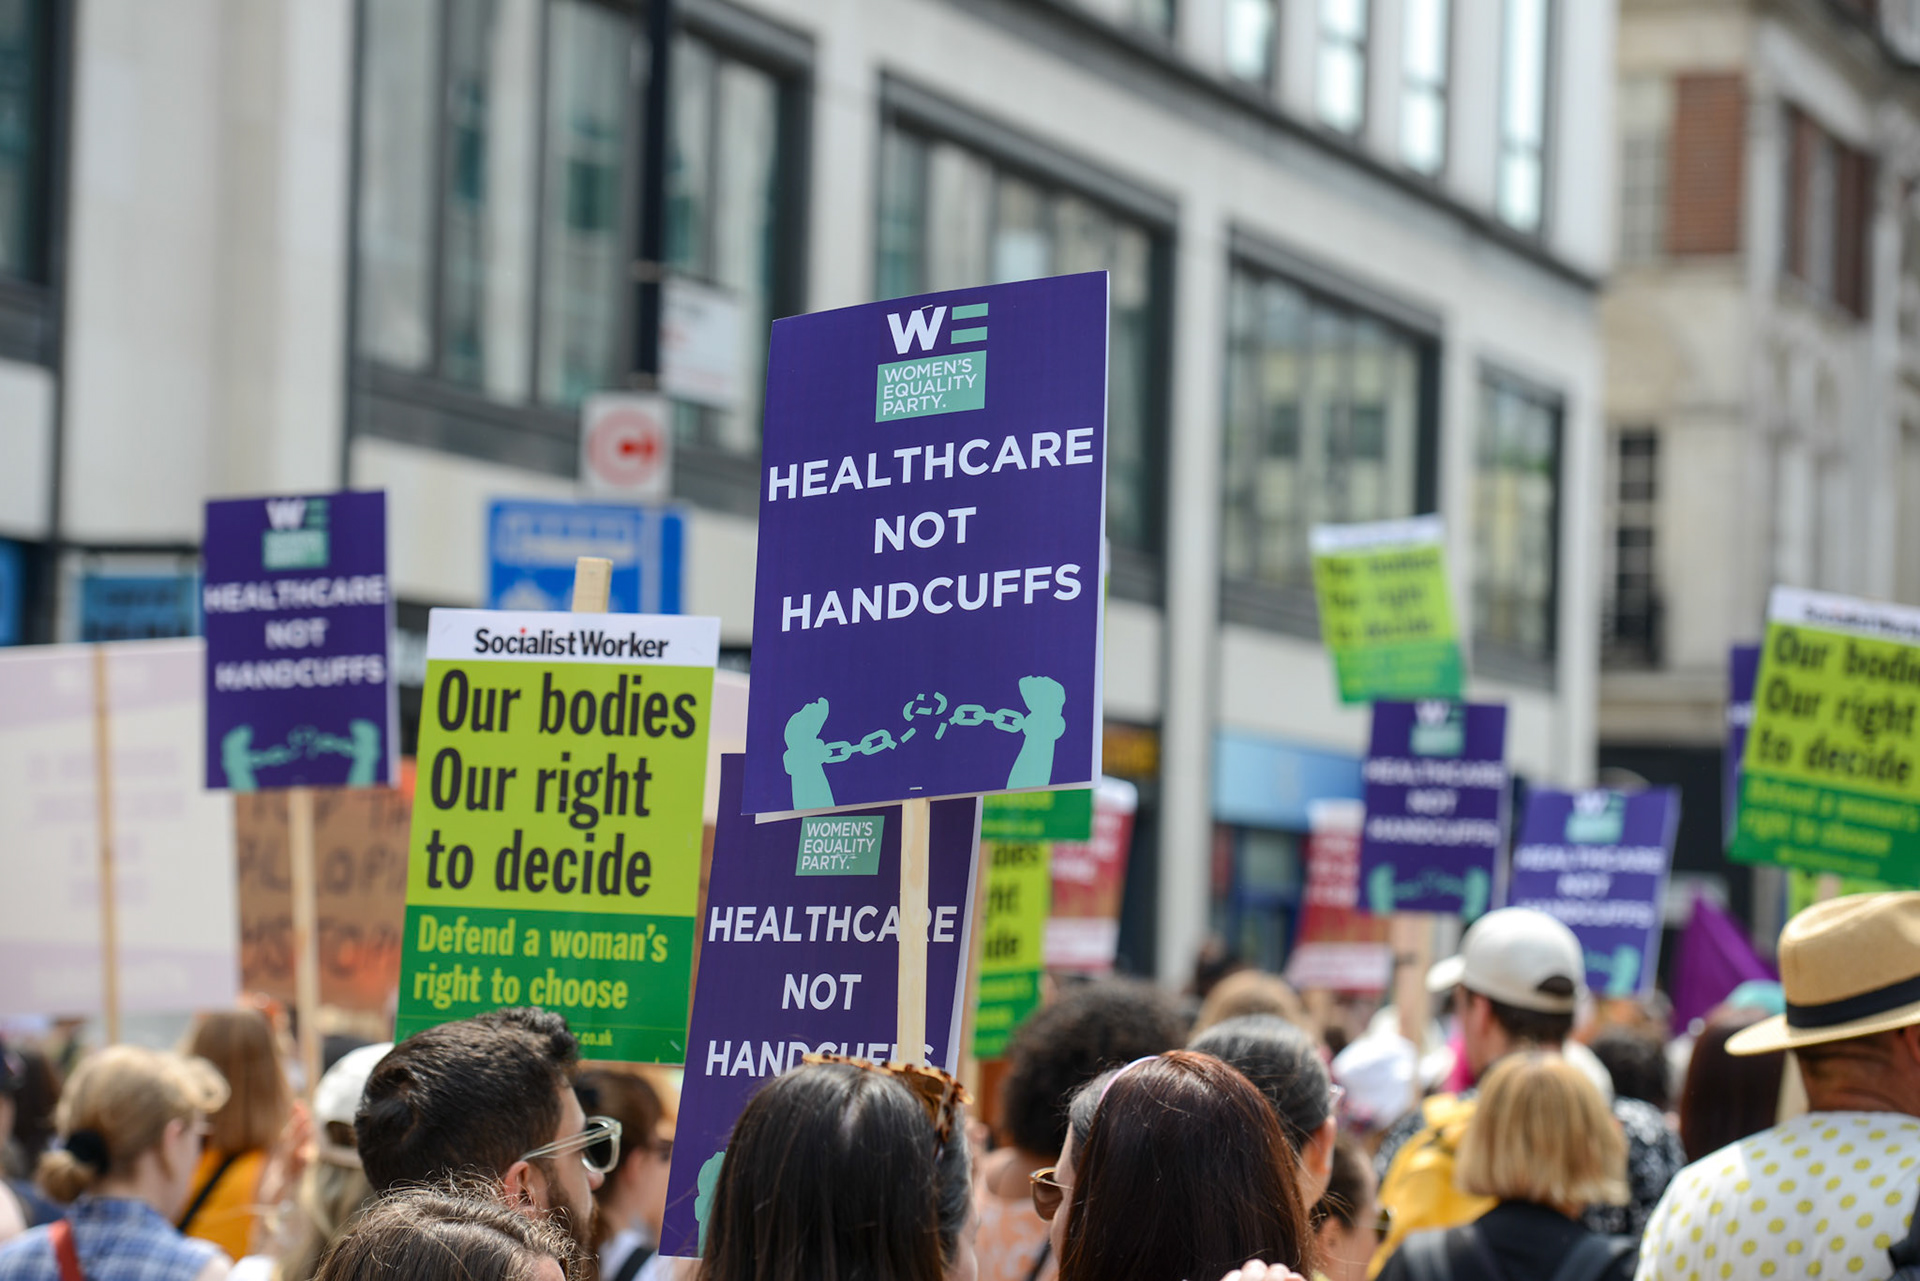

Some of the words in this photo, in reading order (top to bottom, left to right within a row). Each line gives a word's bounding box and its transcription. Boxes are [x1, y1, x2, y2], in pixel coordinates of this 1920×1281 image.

[883, 373, 978, 400] EQUALITY
[884, 358, 973, 383] WOMEN'S
[882, 394, 947, 416] PARTY.
[768, 427, 1094, 502] HEALTHCARE
[874, 507, 976, 554] NOT
[204, 574, 386, 613] HEALTHCARE
[781, 563, 1081, 633] HANDCUFFS
[265, 617, 329, 649] NOT
[215, 654, 385, 691] HANDCUFFS
[438, 669, 521, 732] Our
[539, 672, 697, 738] bodies
[431, 747, 517, 811] Our
[535, 752, 652, 829] right
[804, 838, 876, 854] EQUALITY
[806, 822, 873, 837] WOMEN'S
[426, 829, 474, 889] to
[495, 829, 652, 896] decide
[418, 914, 516, 956] Defend
[523, 927, 540, 957] a
[550, 923, 668, 962] woman's
[708, 906, 958, 942] HEALTHCAE
[414, 963, 483, 1010] right
[491, 967, 521, 1004] to
[529, 967, 629, 1010] choose
[781, 973, 862, 1010] NOT
